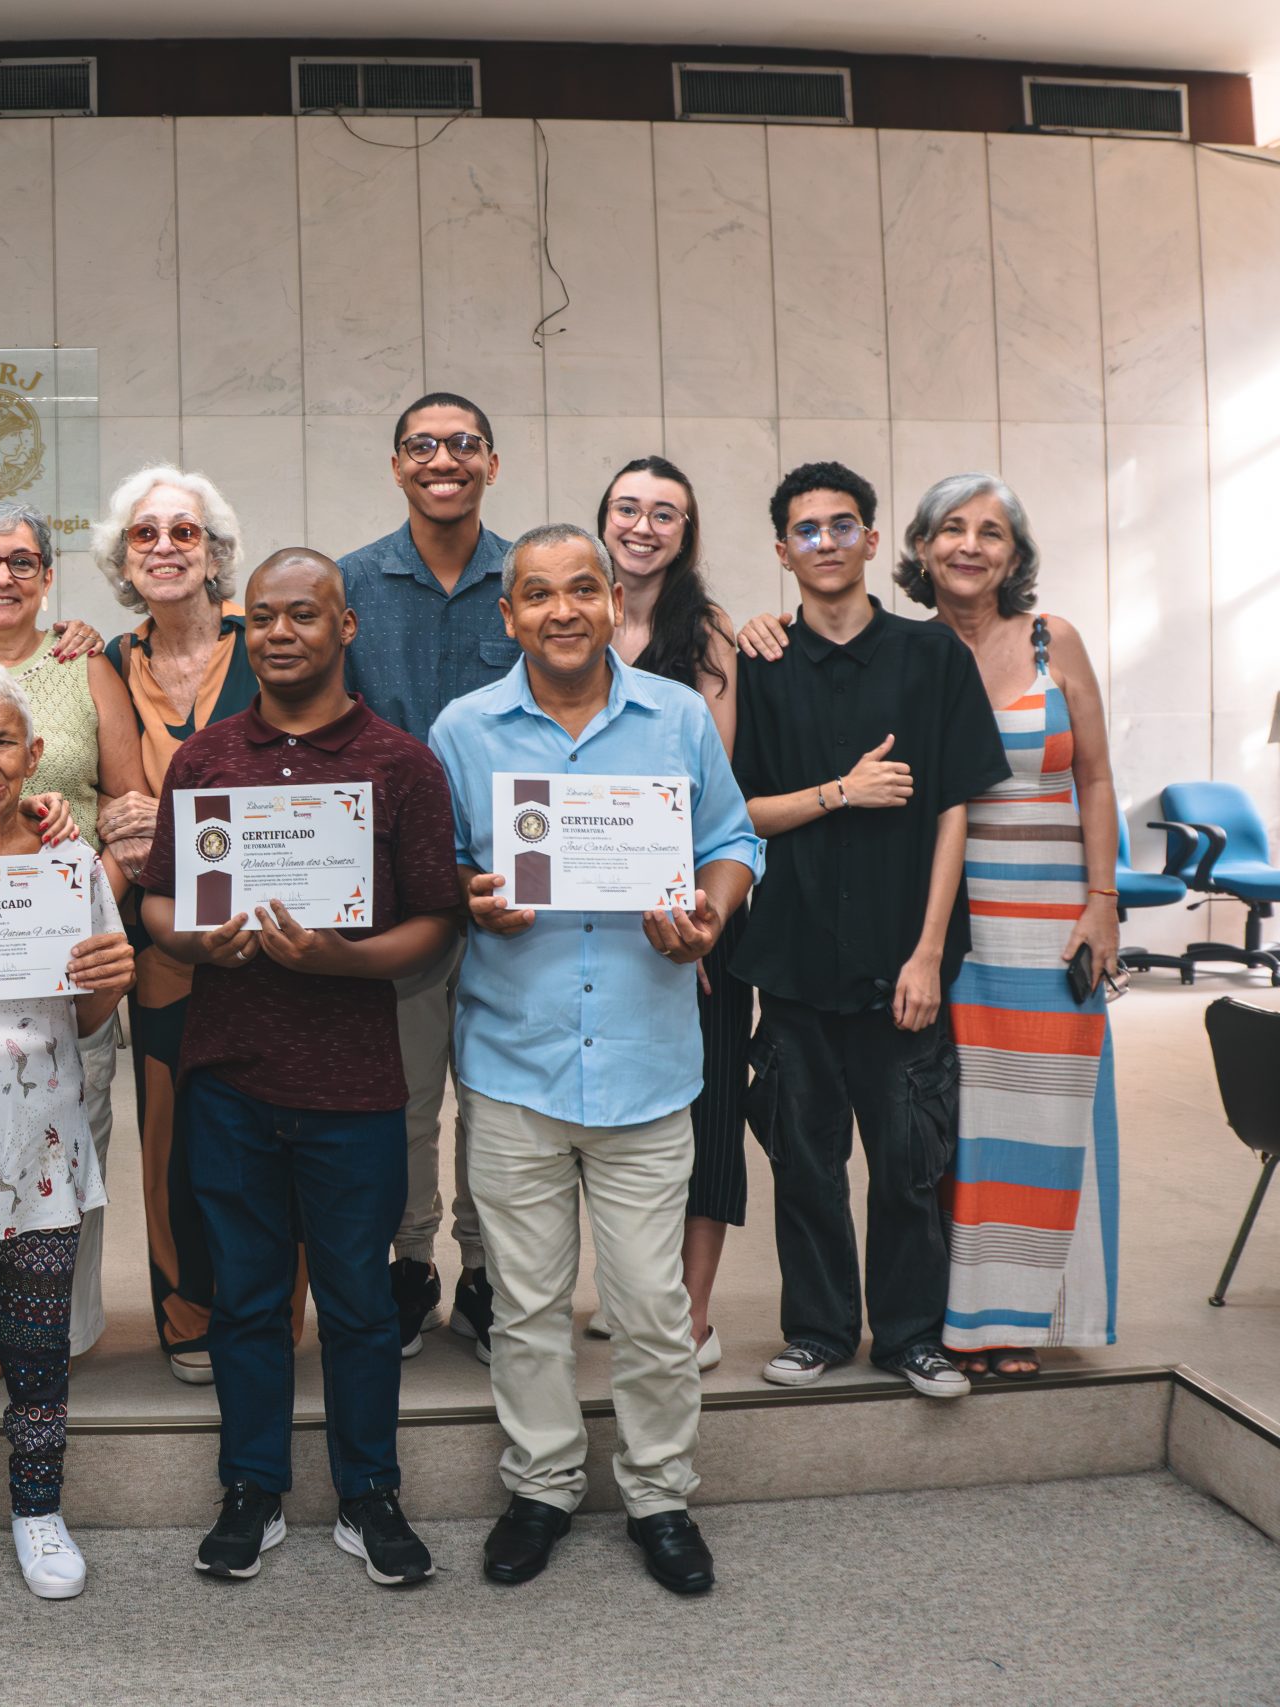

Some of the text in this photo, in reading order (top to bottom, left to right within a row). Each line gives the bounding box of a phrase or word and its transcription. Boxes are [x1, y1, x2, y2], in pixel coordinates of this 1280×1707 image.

[47, 514, 89, 535] logia
[561, 816, 634, 826] CERTIFICADO
[242, 829, 315, 841] CERTIFICADO
[306, 857, 320, 866] dos
[322, 855, 355, 867] Santos
